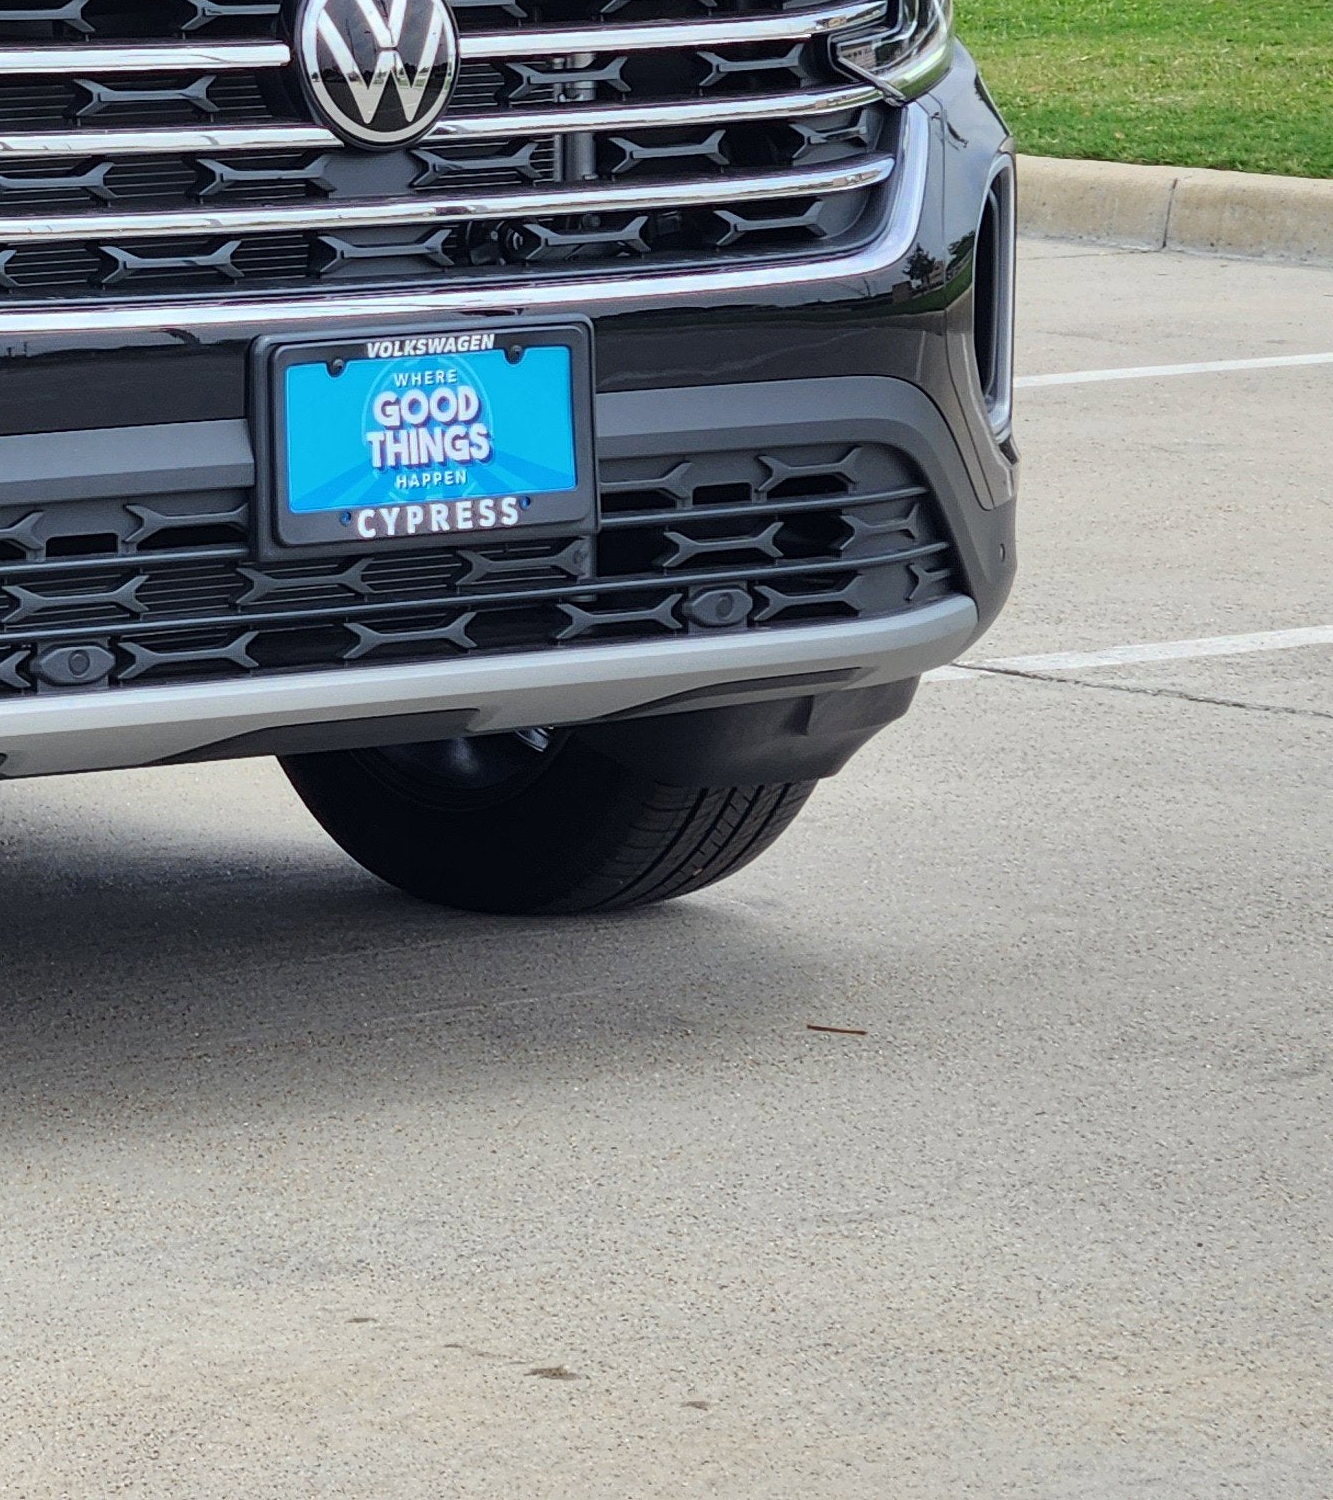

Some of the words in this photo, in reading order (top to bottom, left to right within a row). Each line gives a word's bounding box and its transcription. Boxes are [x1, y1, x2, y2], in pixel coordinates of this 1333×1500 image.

[366, 333, 495, 358] VOLKSWAGEN
[393, 369, 458, 388] WHERE
[373, 385, 480, 427] GOOD
[366, 425, 492, 469] THINGS
[395, 469, 468, 489] HAPPEN
[357, 497, 519, 538] CYPRESS
